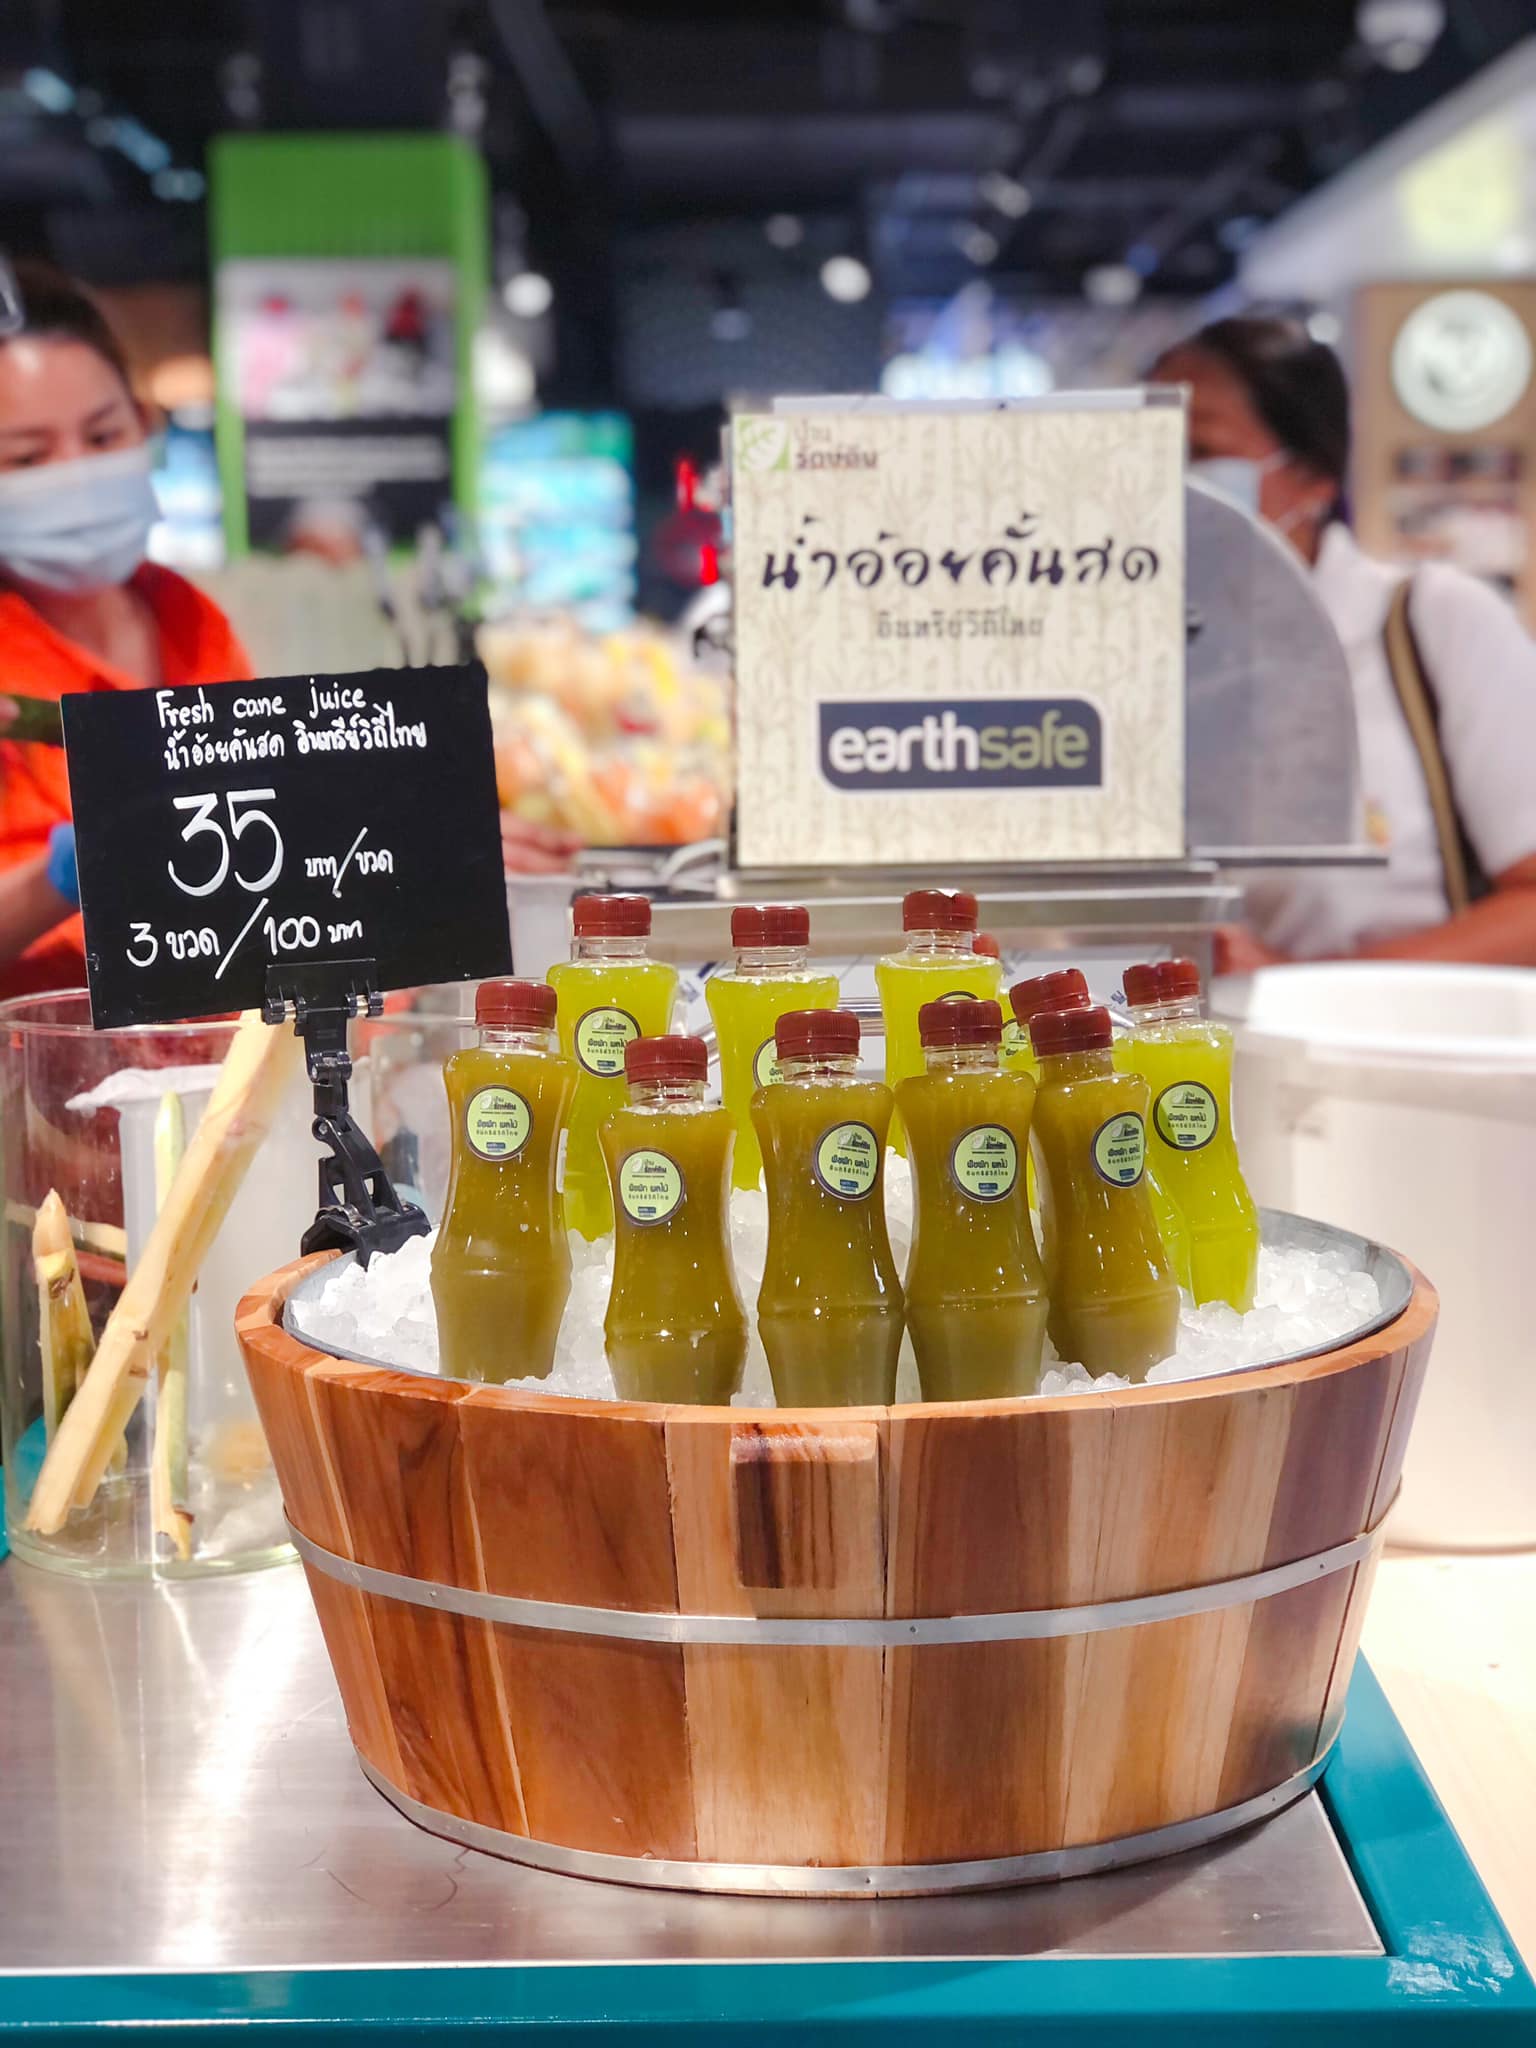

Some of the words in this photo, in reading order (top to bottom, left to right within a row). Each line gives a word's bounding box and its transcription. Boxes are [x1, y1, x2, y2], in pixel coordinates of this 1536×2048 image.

[762, 512, 1161, 590] น้ำอ้อยคั้นสด
[156, 687, 214, 728] Fresh
[233, 695, 287, 719] cane
[309, 678, 367, 719] juice
[828, 710, 1090, 773] earthsafe
[168, 788, 284, 897] 35
[126, 922, 158, 967] 3
[327, 920, 363, 944] บาท
